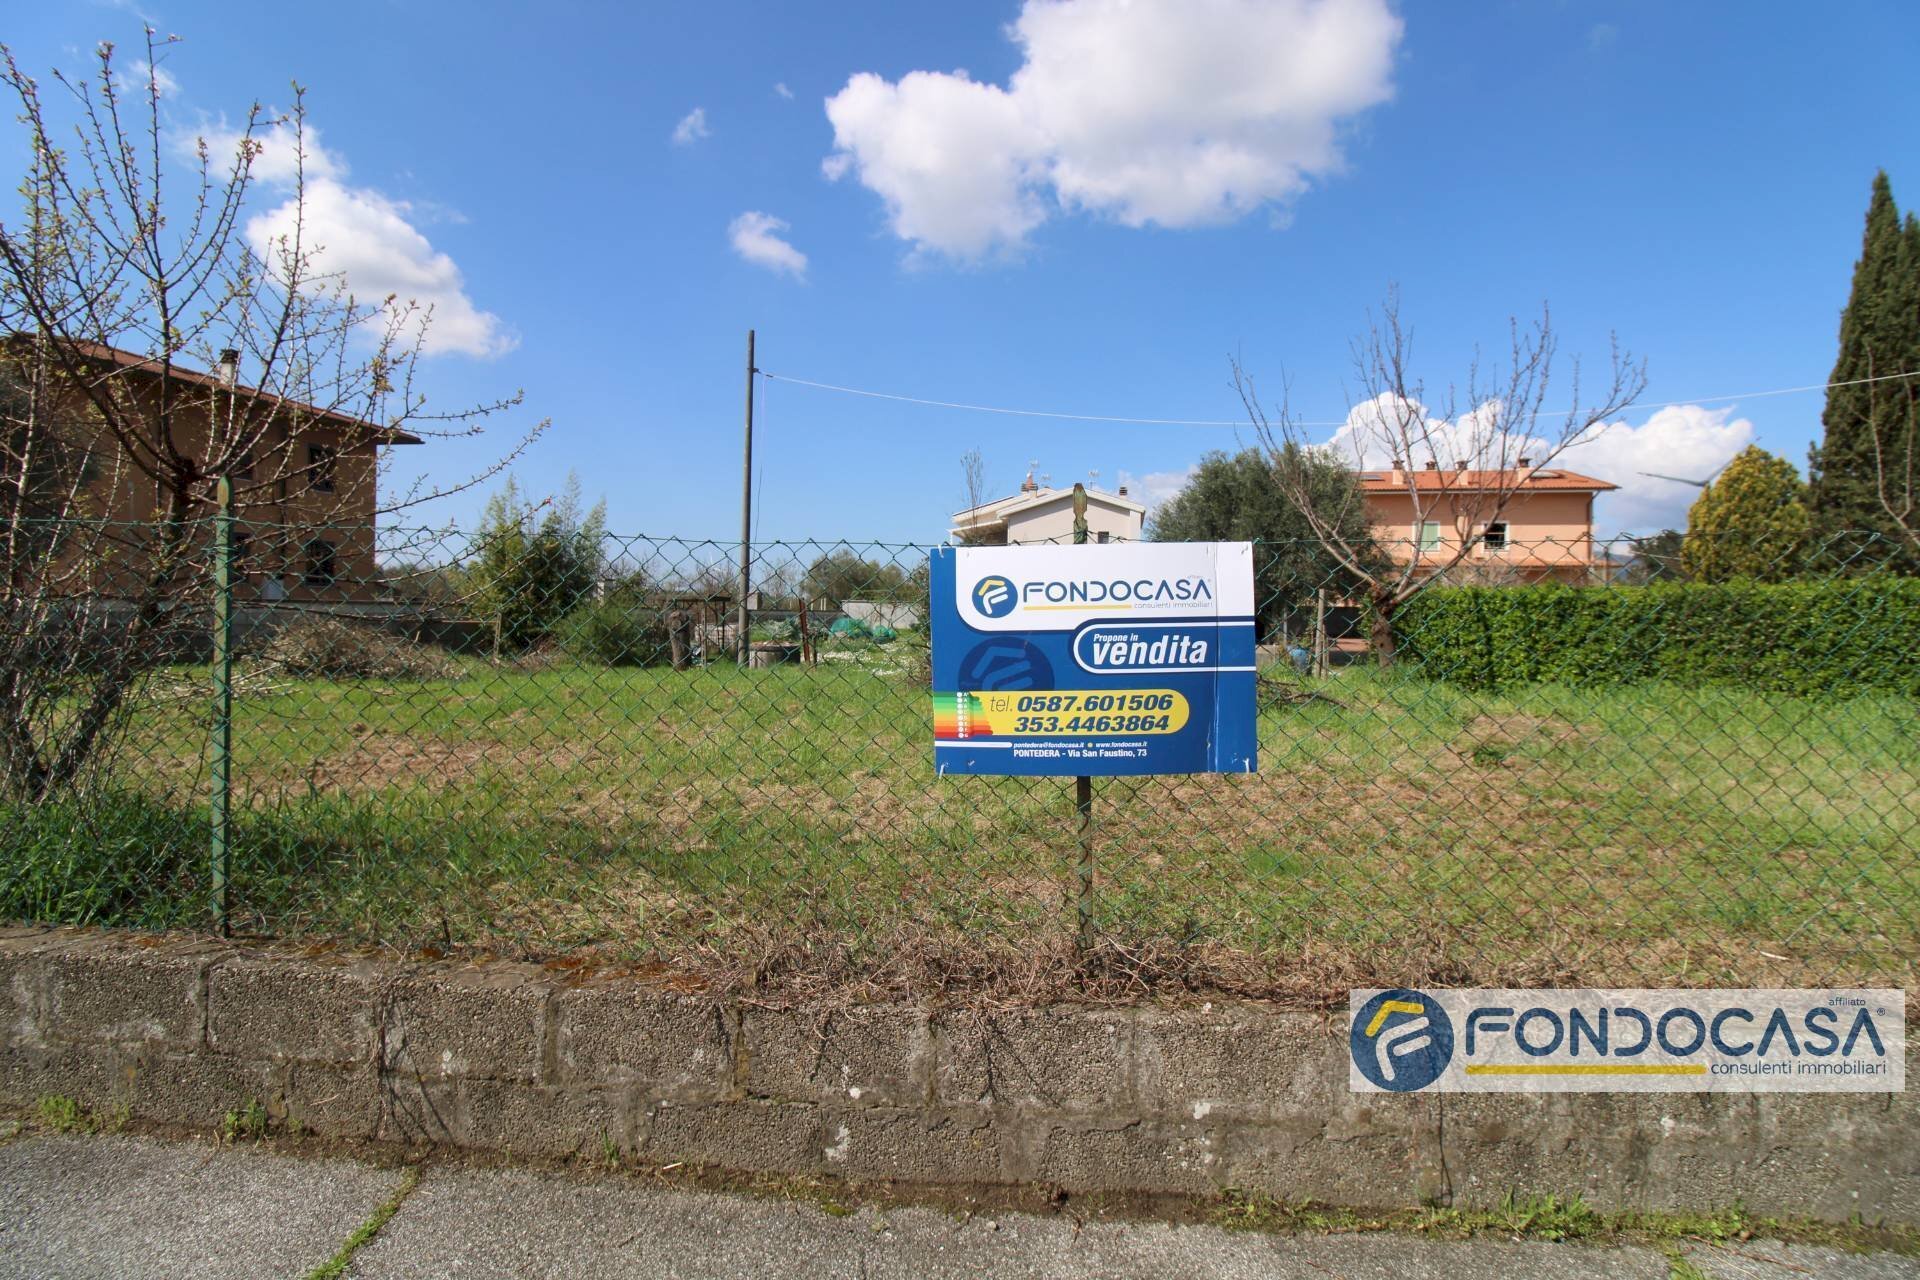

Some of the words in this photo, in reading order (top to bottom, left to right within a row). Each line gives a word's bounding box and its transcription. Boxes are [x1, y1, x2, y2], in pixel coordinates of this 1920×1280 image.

[1022, 579, 1212, 603] FONDOCASA
[1093, 633, 1128, 643] Propone
[1130, 633, 1139, 642] in
[1093, 635, 1208, 665] vendita
[990, 696, 1013, 712] tel.
[1017, 694, 1173, 712] 0587.601506
[1013, 715, 1170, 733] 353.4463864
[1013, 749, 1060, 758] PONTEDERA
[1067, 749, 1081, 758] Via
[1082, 749, 1098, 758] San
[1099, 749, 1136, 758] Faustino,
[1137, 749, 1147, 757] 73
